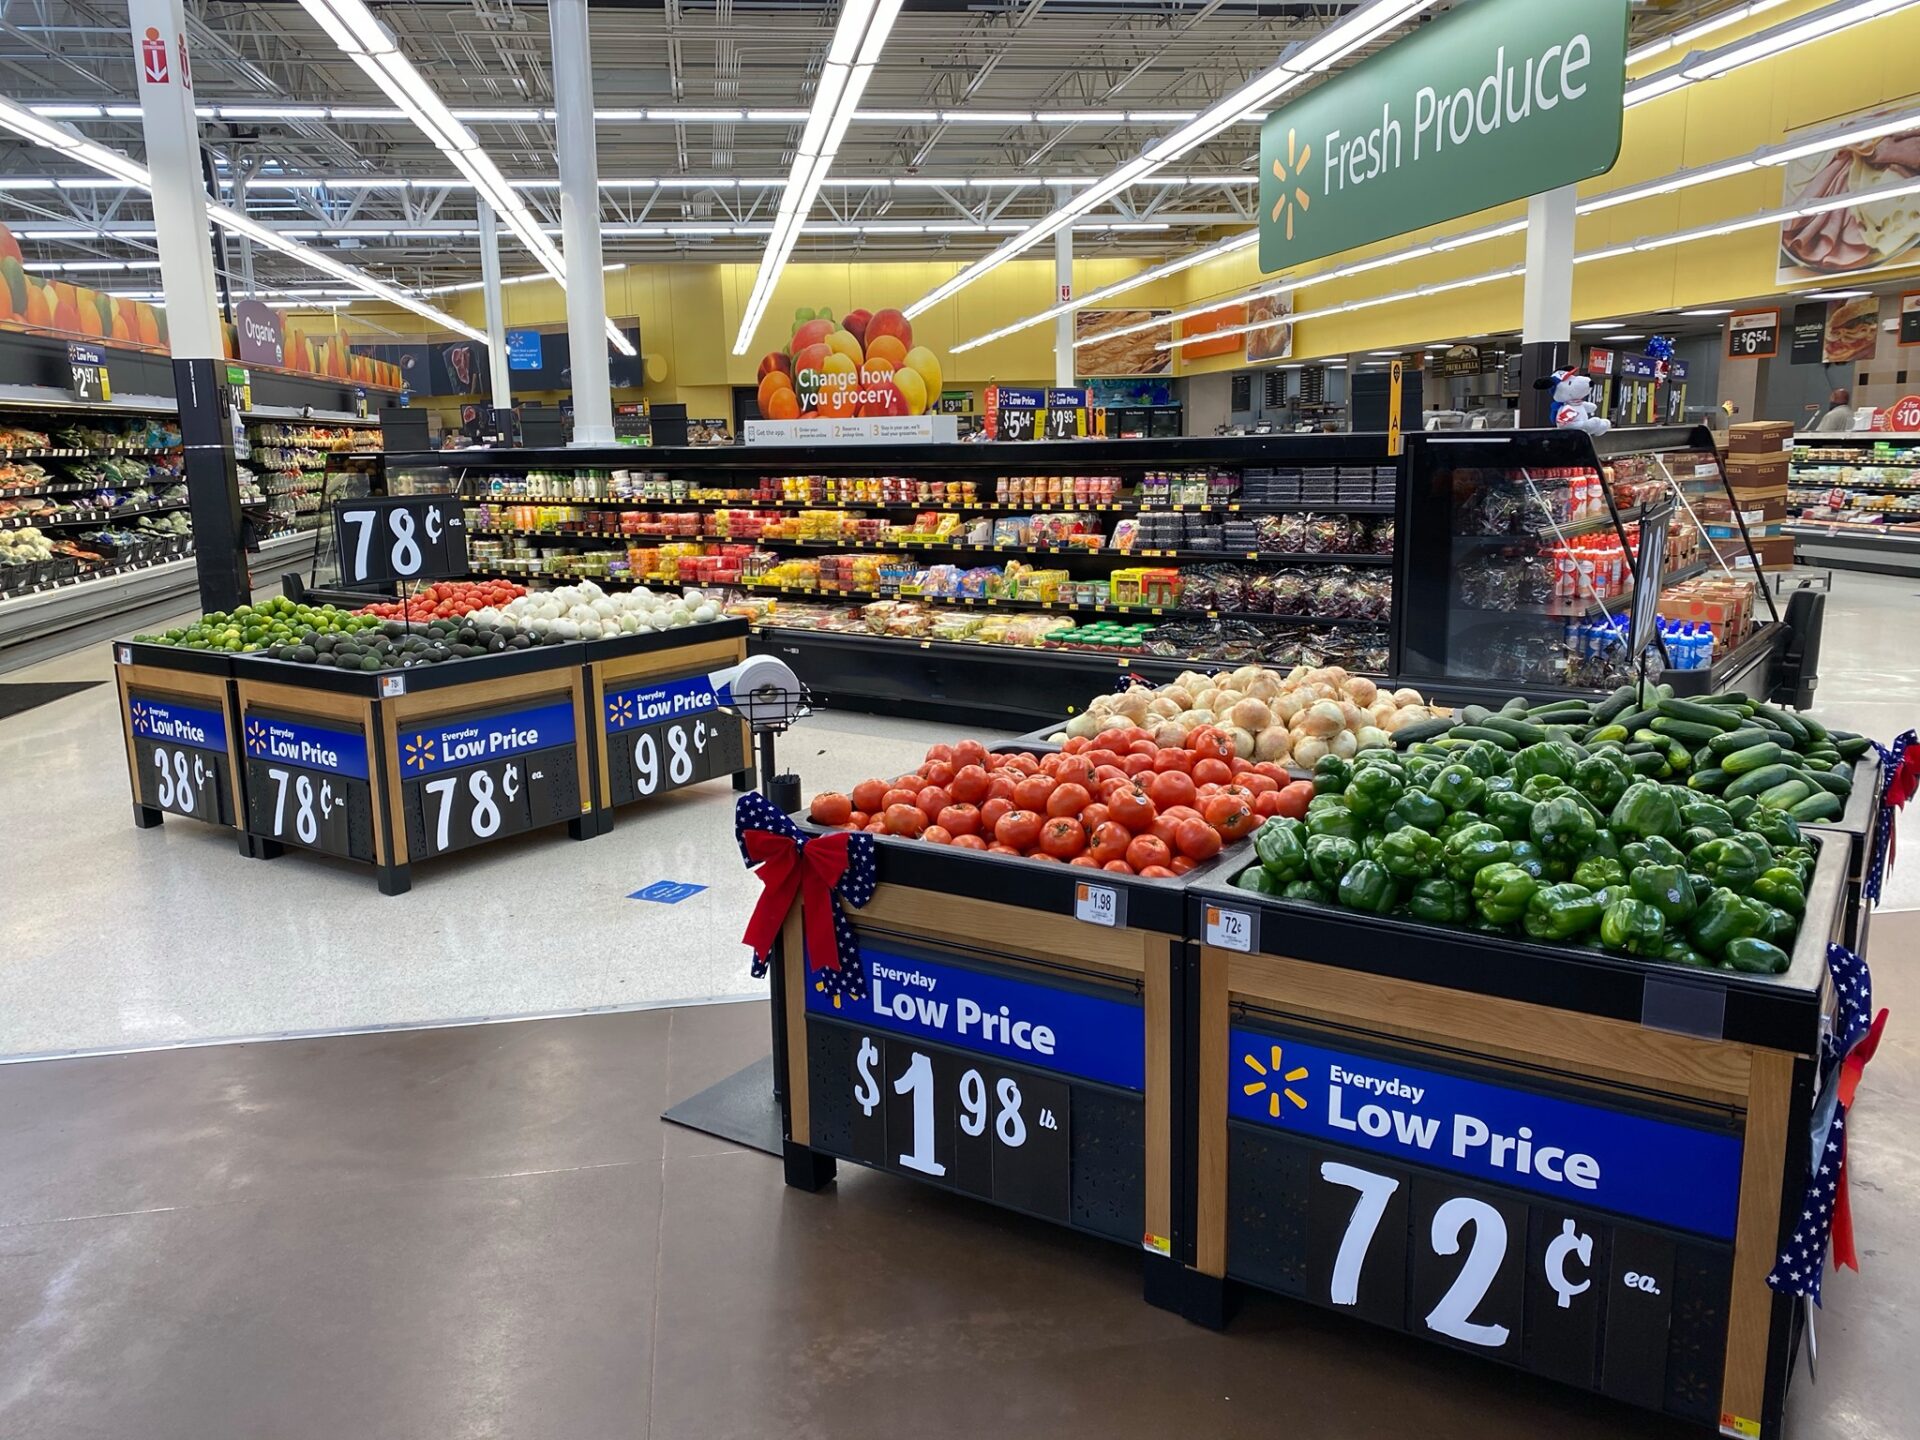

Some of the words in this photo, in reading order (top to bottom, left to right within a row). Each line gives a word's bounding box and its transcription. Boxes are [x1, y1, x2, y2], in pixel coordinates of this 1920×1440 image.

[1325, 103, 1402, 196] Fresh
[1414, 33, 1591, 158] Produce
[245, 316, 276, 347] Organic
[799, 369, 857, 391] Change
[860, 365, 894, 385] how
[801, 391, 828, 412] you
[832, 389, 897, 409] grocery.
[1009, 396, 1021, 405] Low
[1022, 397, 1036, 406] Price
[1056, 397, 1066, 405] Low
[1066, 396, 1079, 405] Price
[1908, 401, 1919, 409] for
[1004, 410, 1030, 438] $564
[1052, 409, 1073, 437] $293
[1392, 414, 1398, 430] A
[1897, 409, 1920, 426] $10
[835, 426, 841, 437] 2
[873, 425, 880, 436] 3
[637, 690, 666, 703] Everyday
[637, 700, 671, 720] Low
[674, 691, 711, 713] Price
[149, 707, 169, 719] Everyday
[150, 716, 174, 736] Low
[175, 719, 205, 743] Price
[270, 726, 294, 741] Everyday
[442, 728, 479, 742] Everyday
[270, 735, 299, 760] Low
[301, 741, 338, 767] Price
[442, 739, 486, 763] Low
[489, 728, 538, 752] Price
[531, 771, 544, 780] ea.
[1224, 916, 1242, 935] 72¢
[872, 962, 937, 992] Everyday
[872, 978, 949, 1029] Low
[956, 997, 1056, 1056] Price
[1329, 1065, 1425, 1104] Everyday
[1039, 1108, 1058, 1130] lb.
[1328, 1085, 1439, 1150] Low
[1451, 1113, 1600, 1190] Price
[1623, 1269, 1661, 1296] ea.
